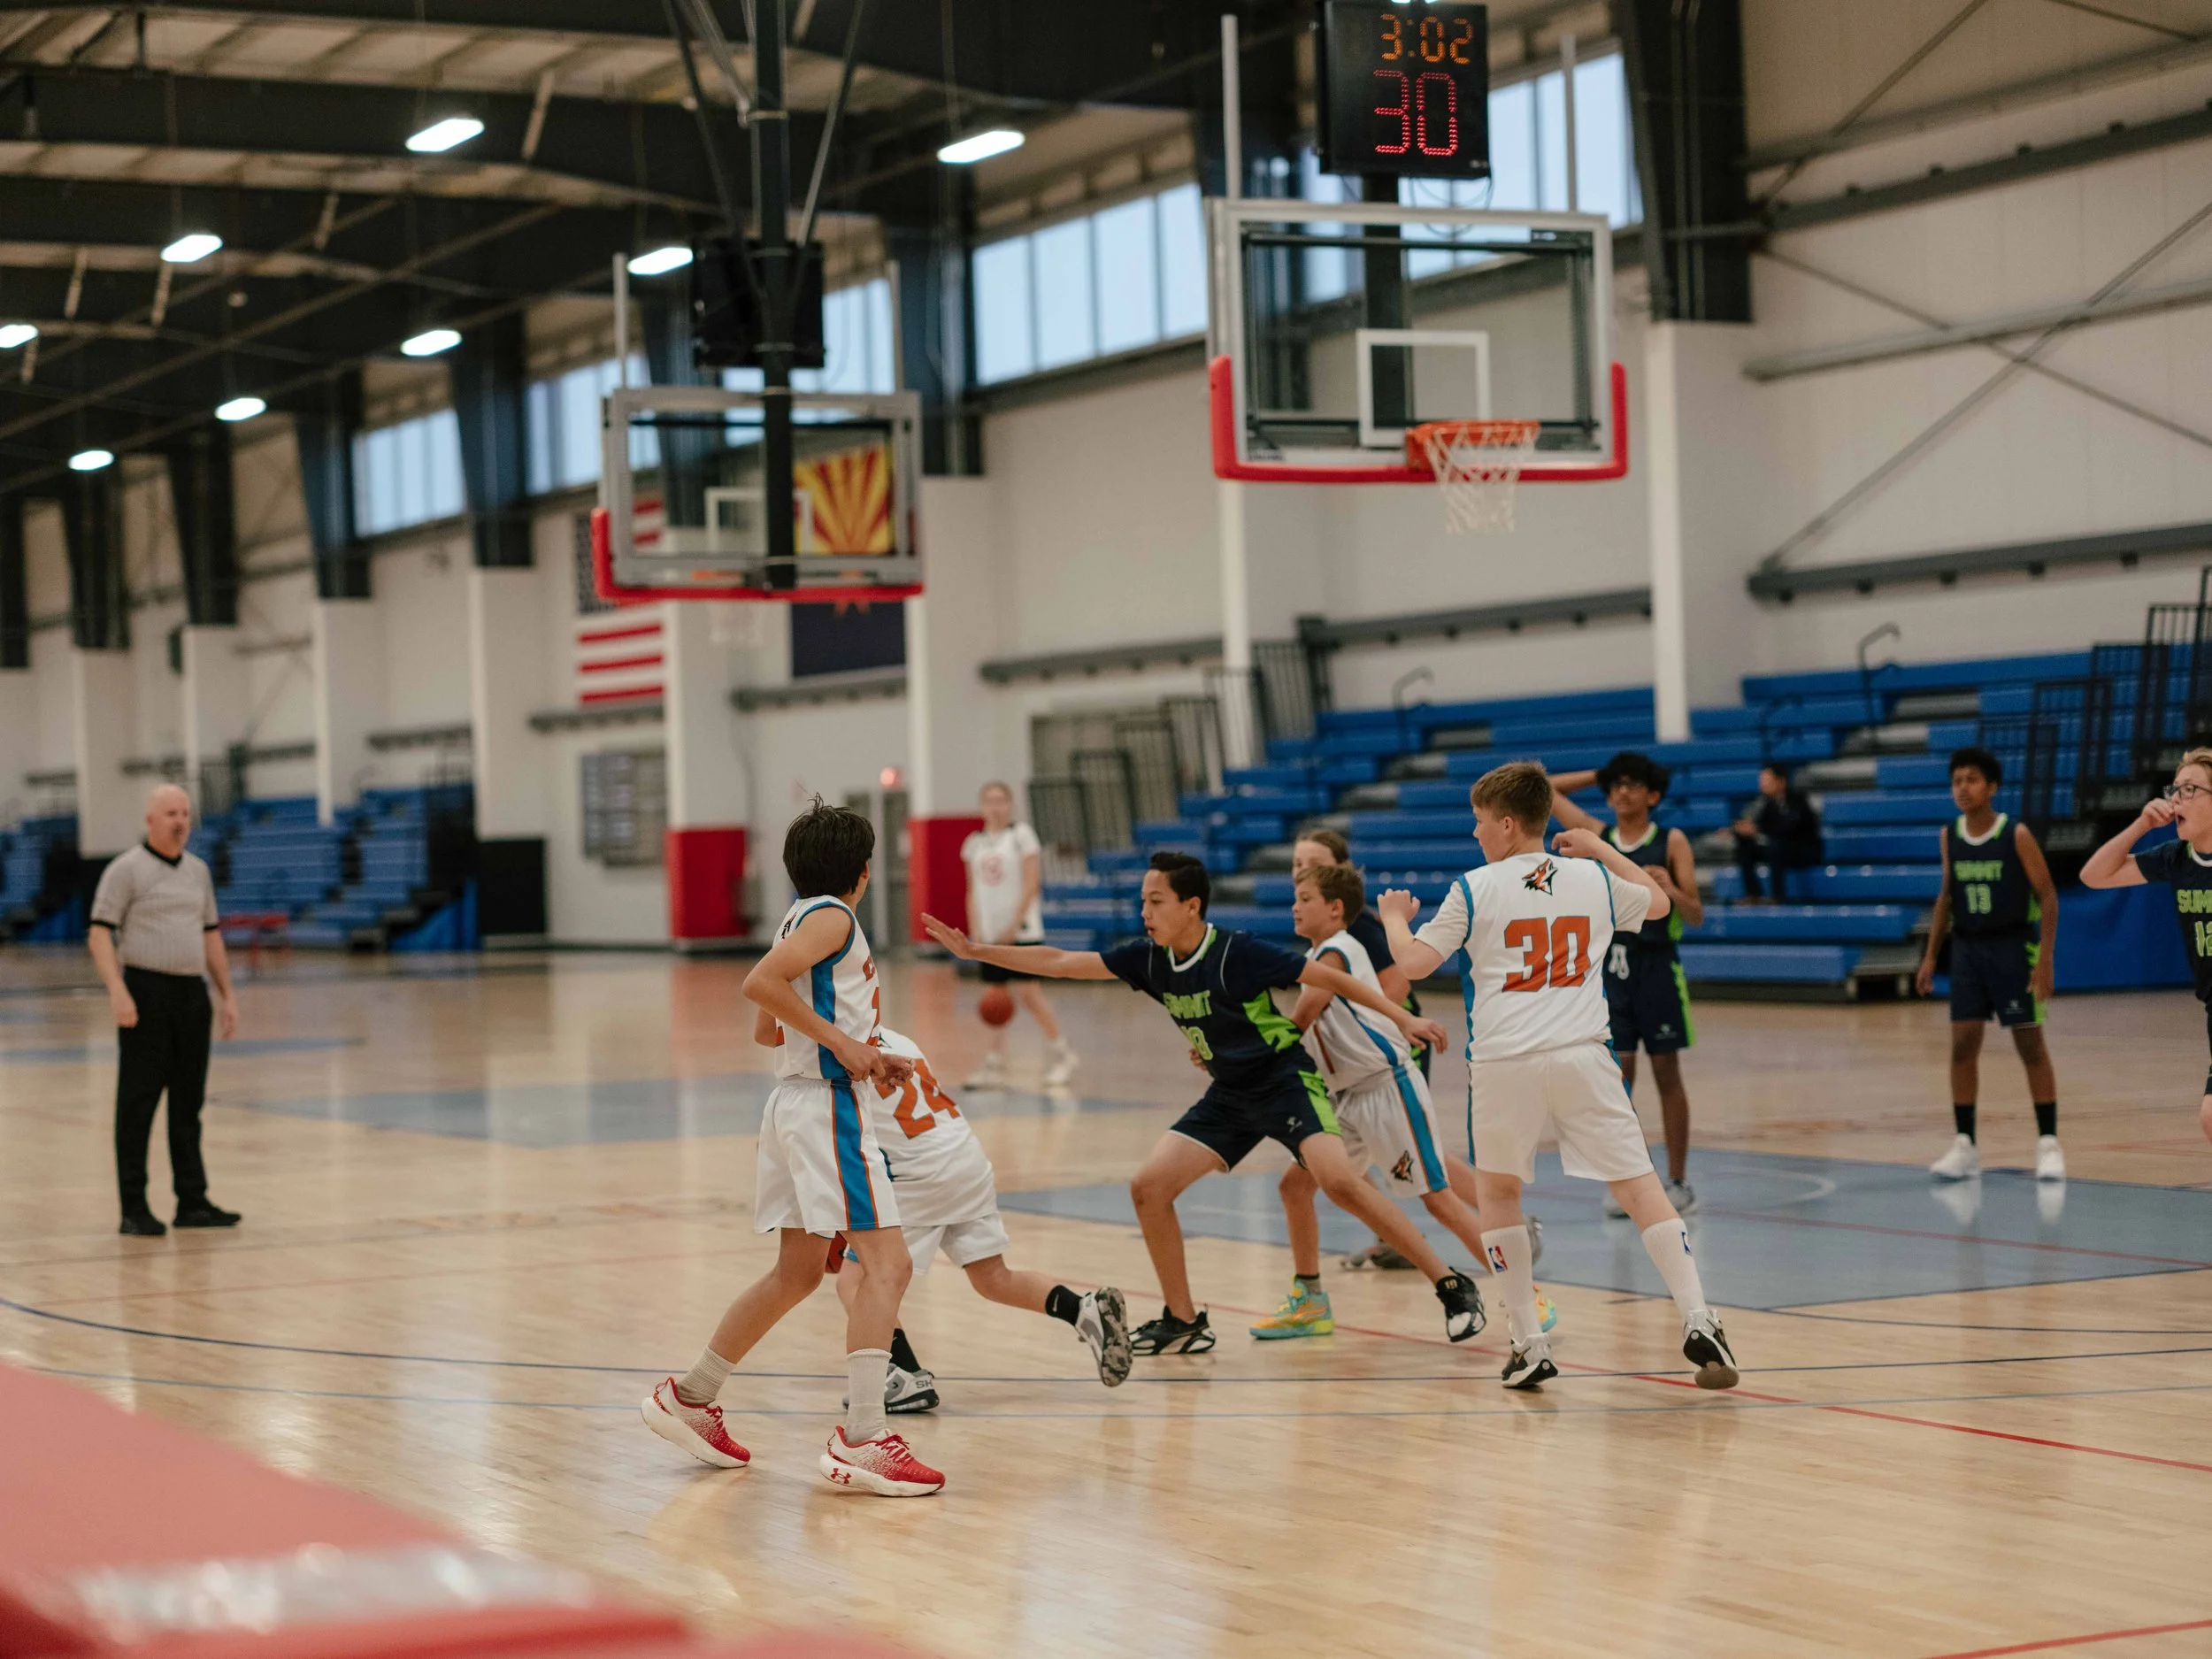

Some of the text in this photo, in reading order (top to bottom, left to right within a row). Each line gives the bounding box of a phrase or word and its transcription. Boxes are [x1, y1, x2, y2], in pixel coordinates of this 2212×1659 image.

[1380, 13, 1474, 65] 3:02
[1373, 69, 1459, 157] 30
[1966, 884, 1991, 914] 13
[1502, 916, 1592, 993] 30
[875, 1058, 961, 1141] 24
